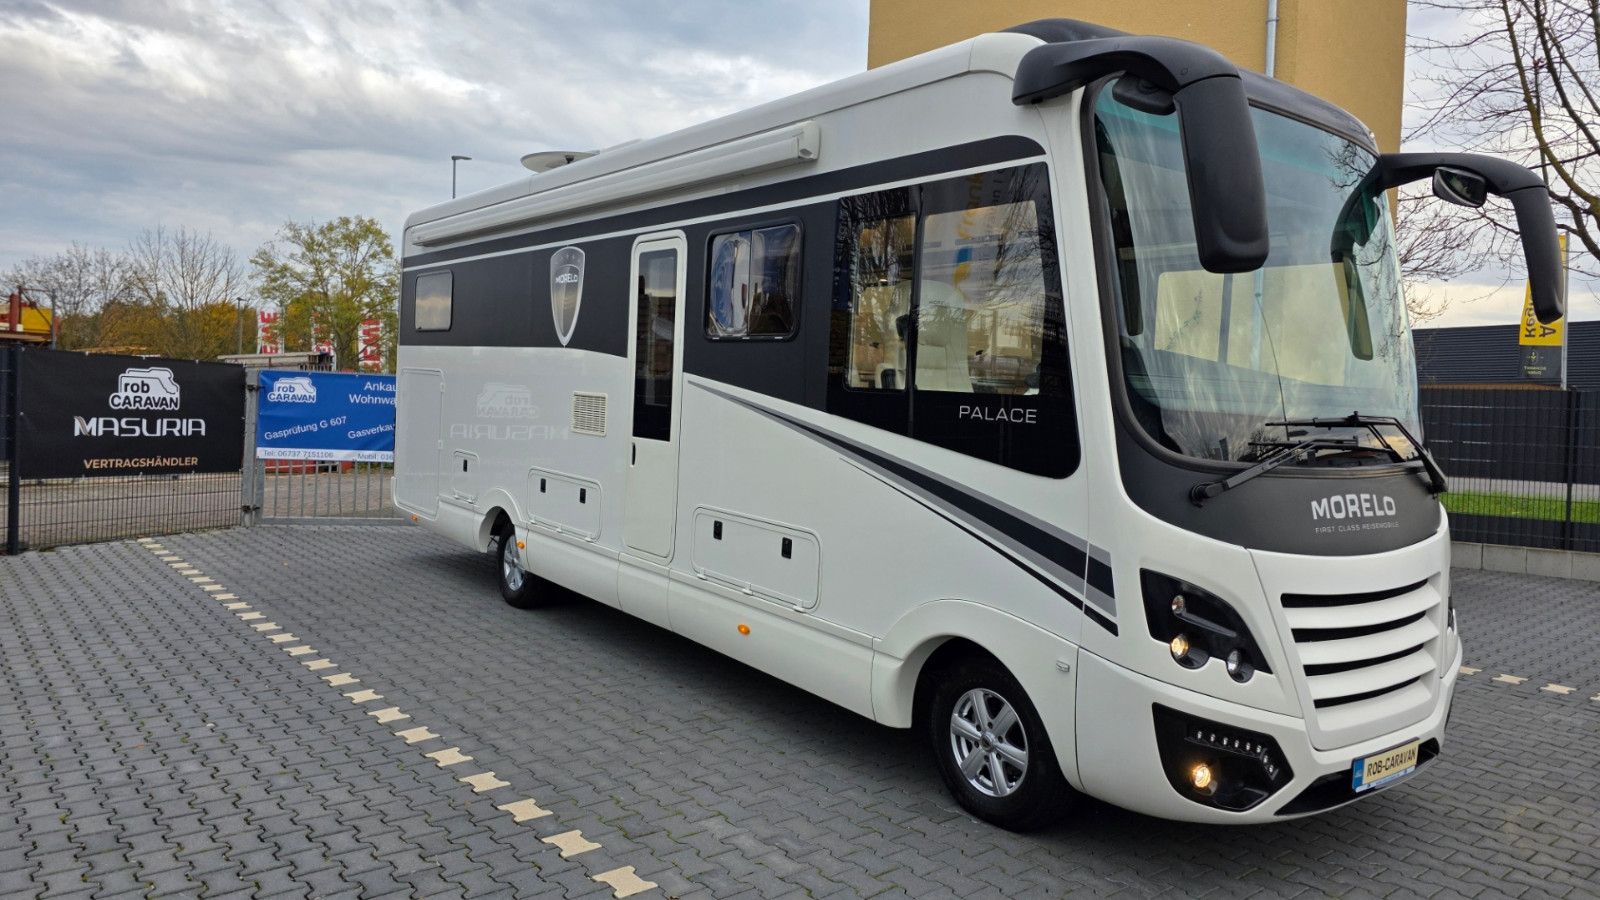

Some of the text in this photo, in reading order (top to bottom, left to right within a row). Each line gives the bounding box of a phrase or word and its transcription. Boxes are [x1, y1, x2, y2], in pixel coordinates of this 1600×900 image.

[555, 273, 578, 284] MORELO
[124, 381, 150, 393] rob
[277, 385, 296, 393] rob
[110, 395, 179, 409] CARAVAN
[268, 392, 316, 402] CARAVAN
[348, 393, 397, 407] Wohnwa
[958, 404, 1038, 425] PALACE
[74, 416, 206, 437] MASURIA
[264, 415, 347, 440] Gasprüfung G 607
[347, 424, 396, 439] Gasverkau
[84, 456, 199, 469] VERTRAGSHÄNDLER
[1310, 493, 1397, 520] MORELO
[1315, 525, 1335, 534] FIRST
[1338, 523, 1361, 533] CLASS
[1367, 747, 1416, 777] ROB-CARAVAN
